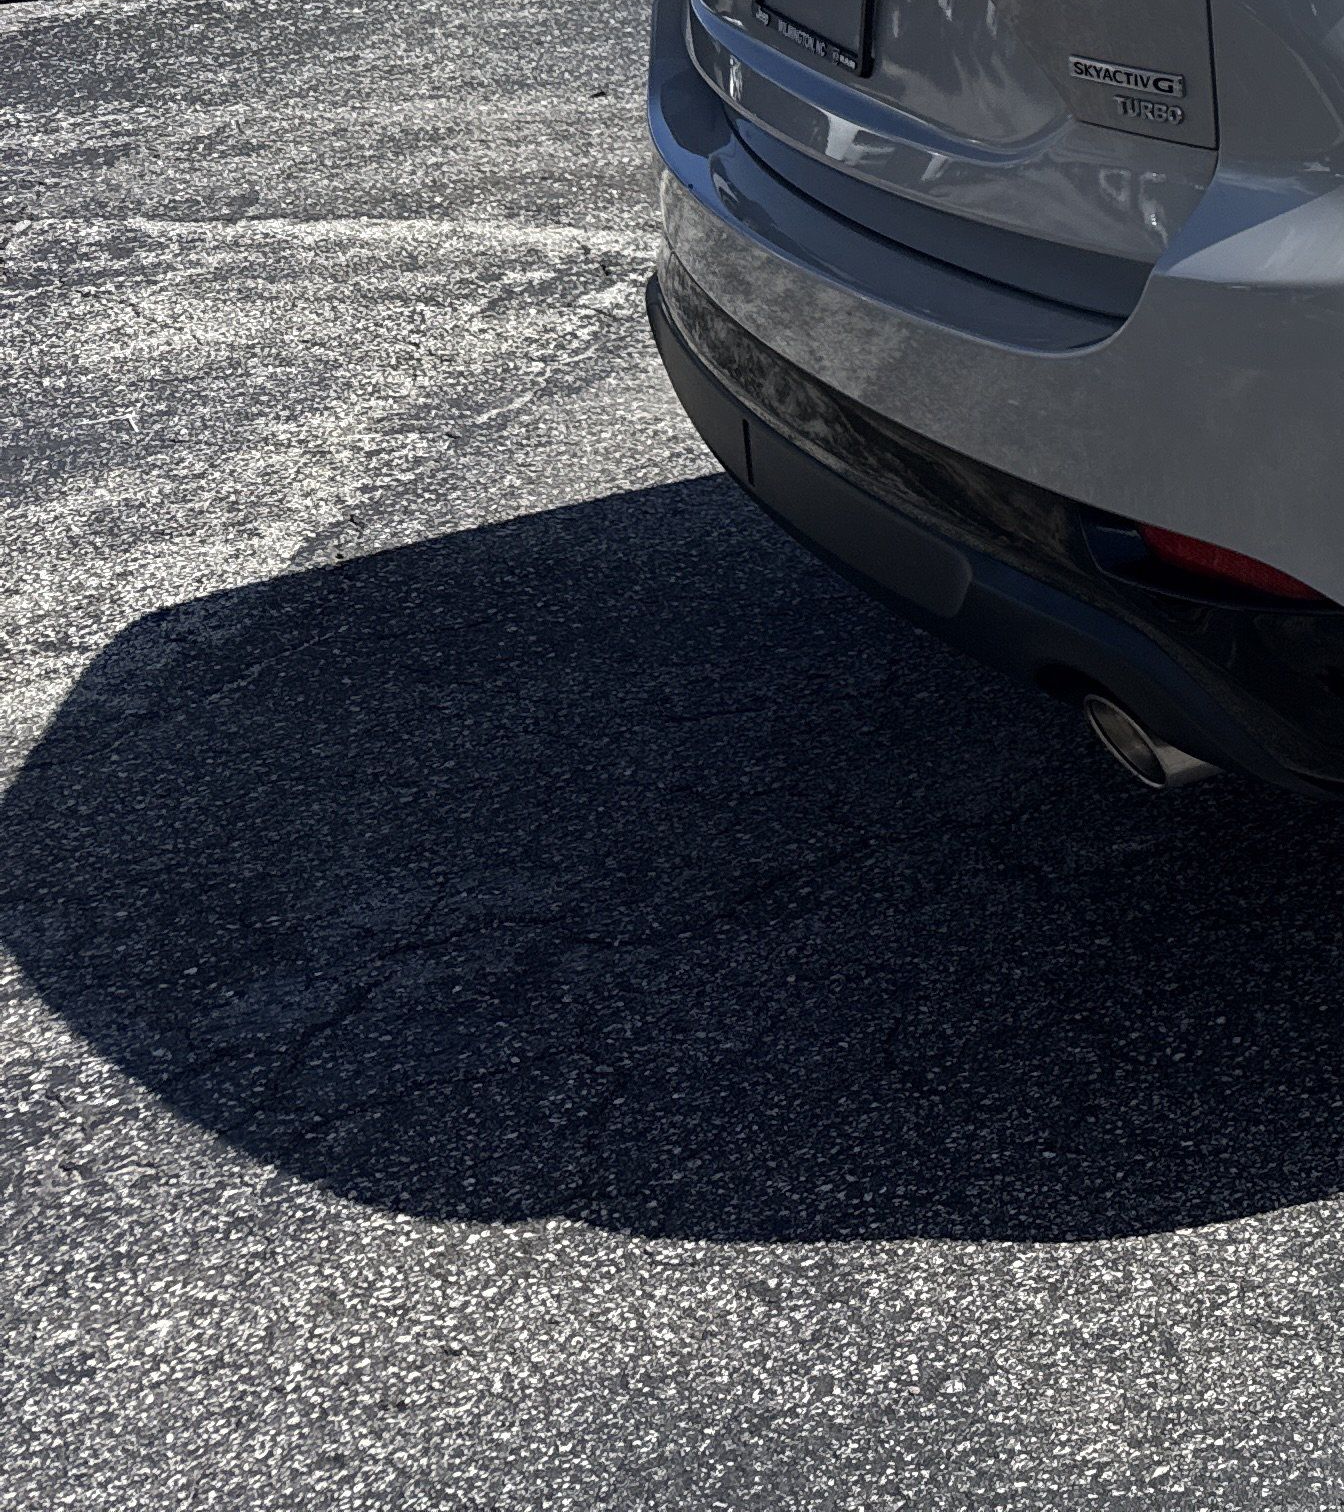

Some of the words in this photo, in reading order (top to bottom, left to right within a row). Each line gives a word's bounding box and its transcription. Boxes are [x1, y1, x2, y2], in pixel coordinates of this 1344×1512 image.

[1072, 61, 1151, 89] SKYACTIV
[1152, 76, 1176, 94] G
[1112, 93, 1184, 126] TURBO
